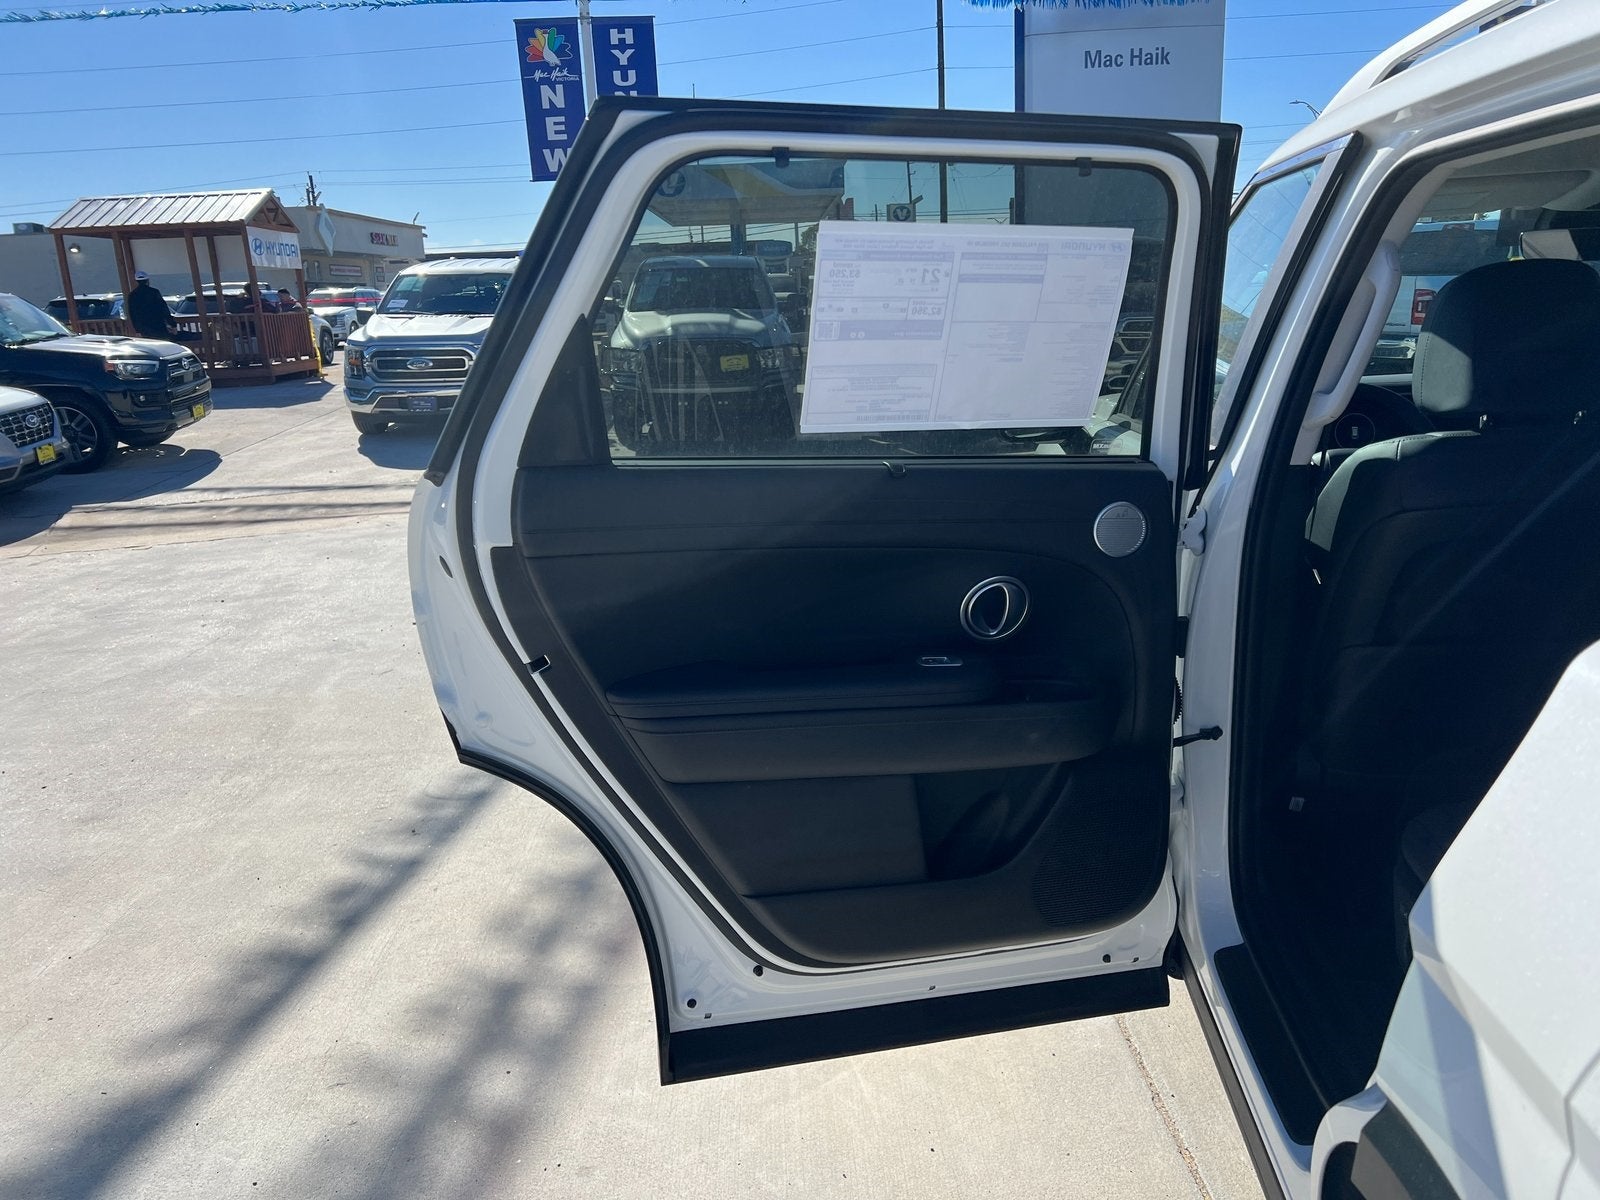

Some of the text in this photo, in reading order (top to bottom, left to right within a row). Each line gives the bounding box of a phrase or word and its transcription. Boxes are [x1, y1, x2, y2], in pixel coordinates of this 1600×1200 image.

[1084, 46, 1170, 69] Mac Haik
[540, 84, 573, 173] NEW
[265, 240, 299, 257] HYUNDAI
